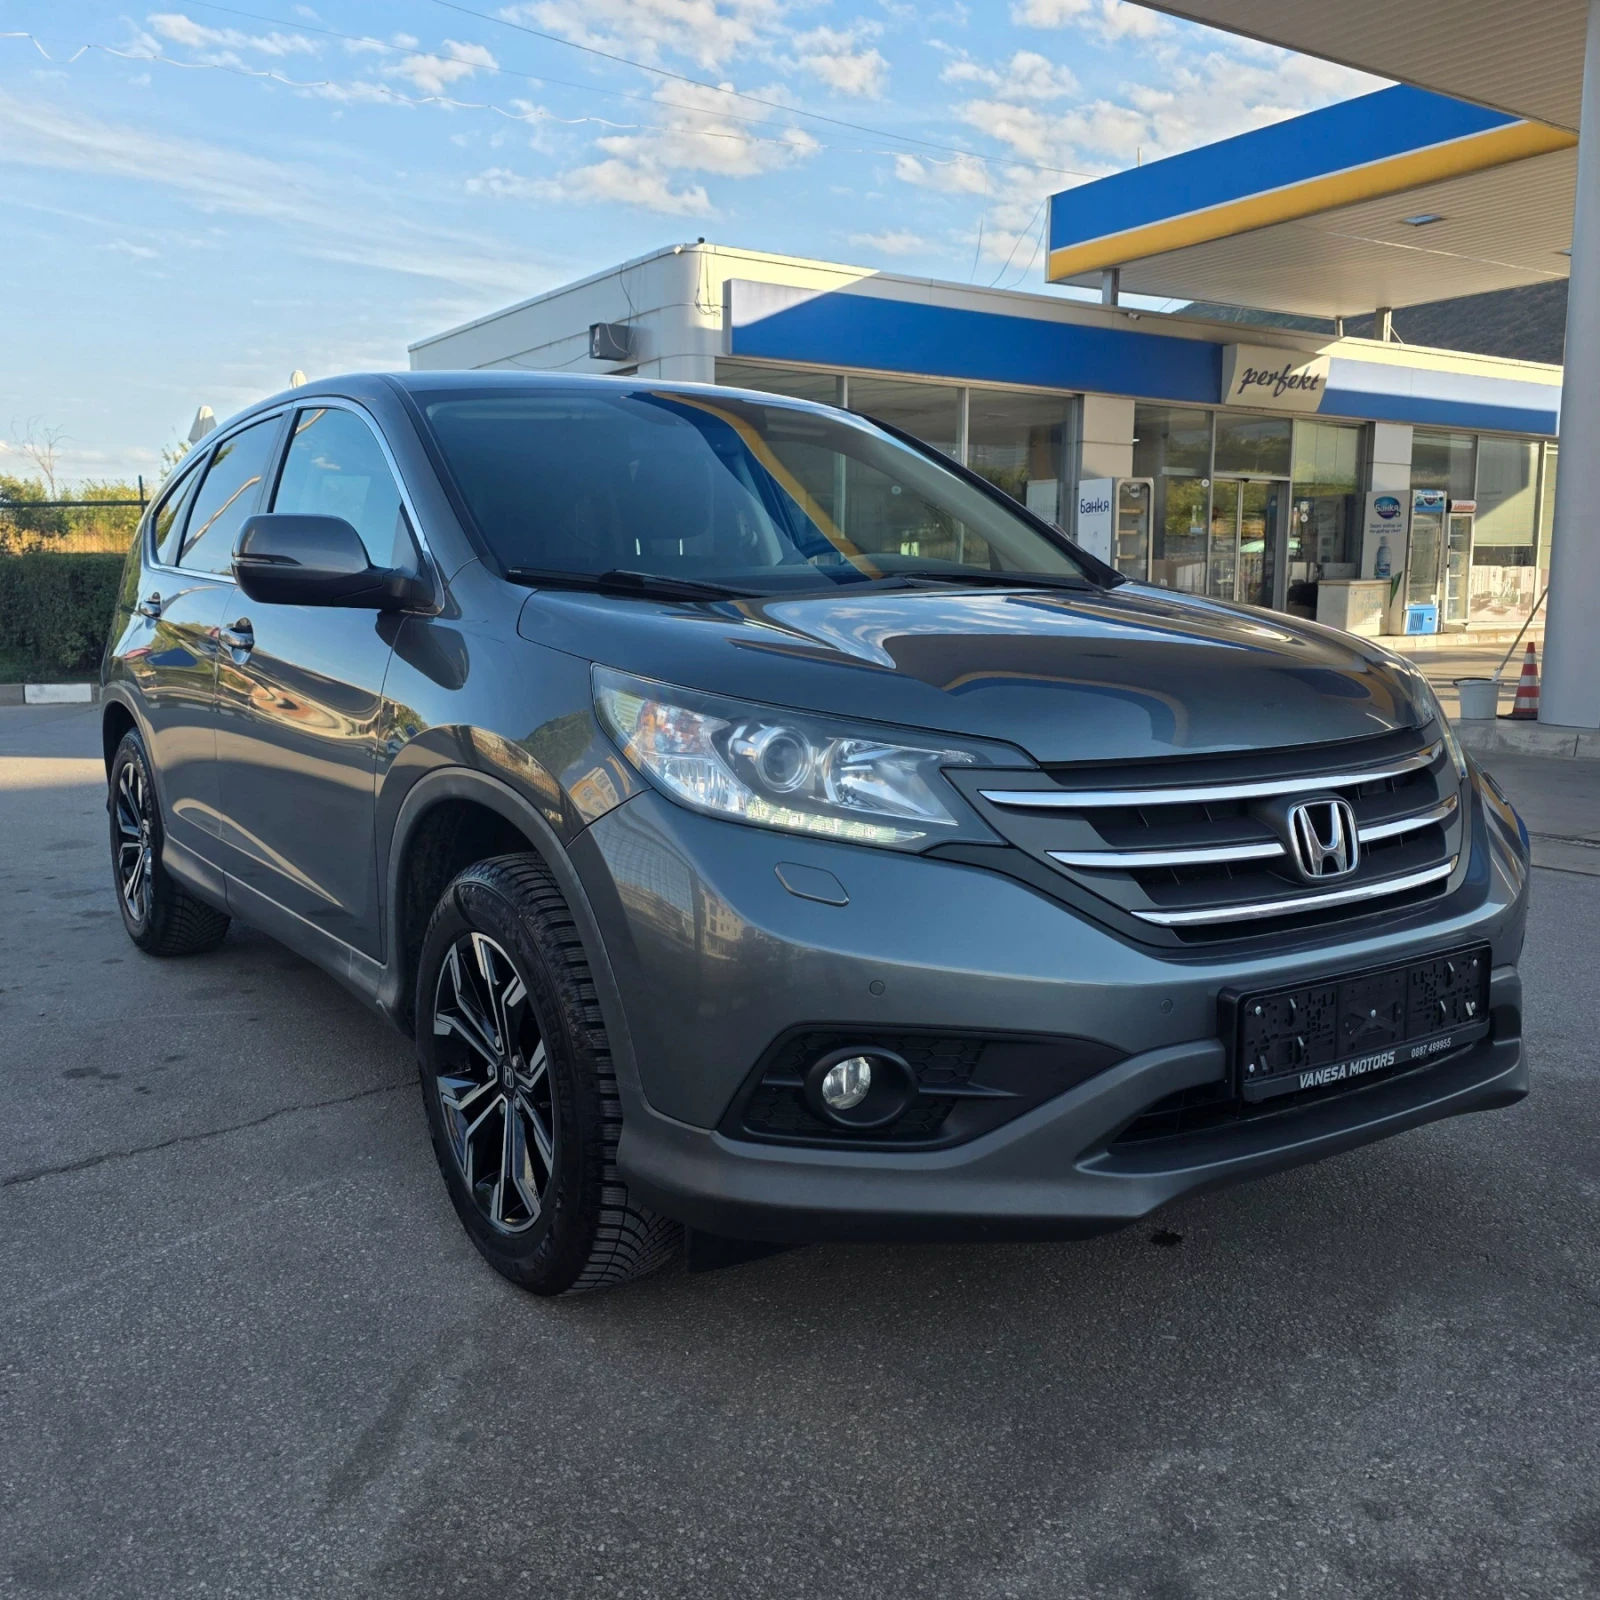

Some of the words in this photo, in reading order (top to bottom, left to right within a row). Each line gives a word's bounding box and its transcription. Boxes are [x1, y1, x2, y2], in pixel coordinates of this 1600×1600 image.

[1237, 364, 1320, 397] perfekt
[1300, 1064, 1346, 1089] VANESA
[1349, 1051, 1395, 1077] MOTORS
